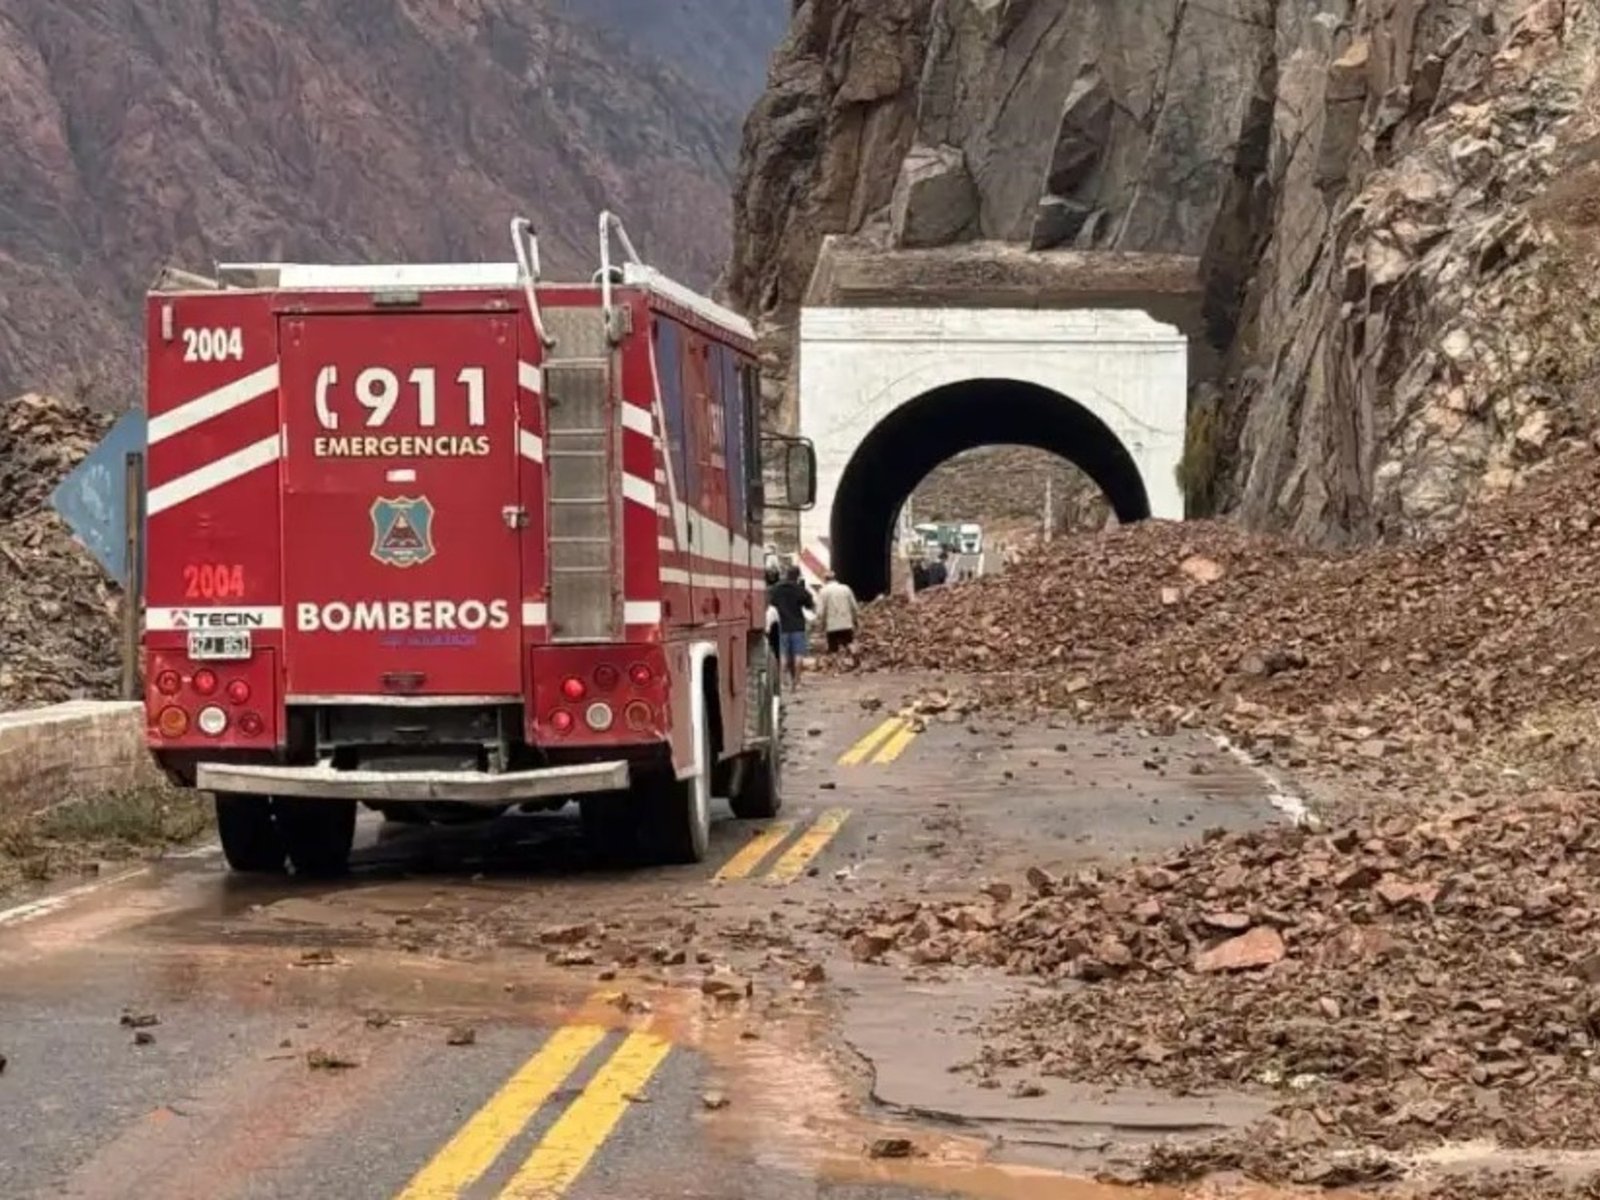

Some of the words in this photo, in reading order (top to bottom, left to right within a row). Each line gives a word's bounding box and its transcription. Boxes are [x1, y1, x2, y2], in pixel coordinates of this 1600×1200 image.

[182, 327, 244, 362] 2004
[355, 367, 485, 427] 911
[314, 436, 491, 456] EMERGENCIAS
[183, 564, 245, 598] 2004
[193, 613, 263, 626] TECIN
[297, 599, 510, 632] BOMBEROS
